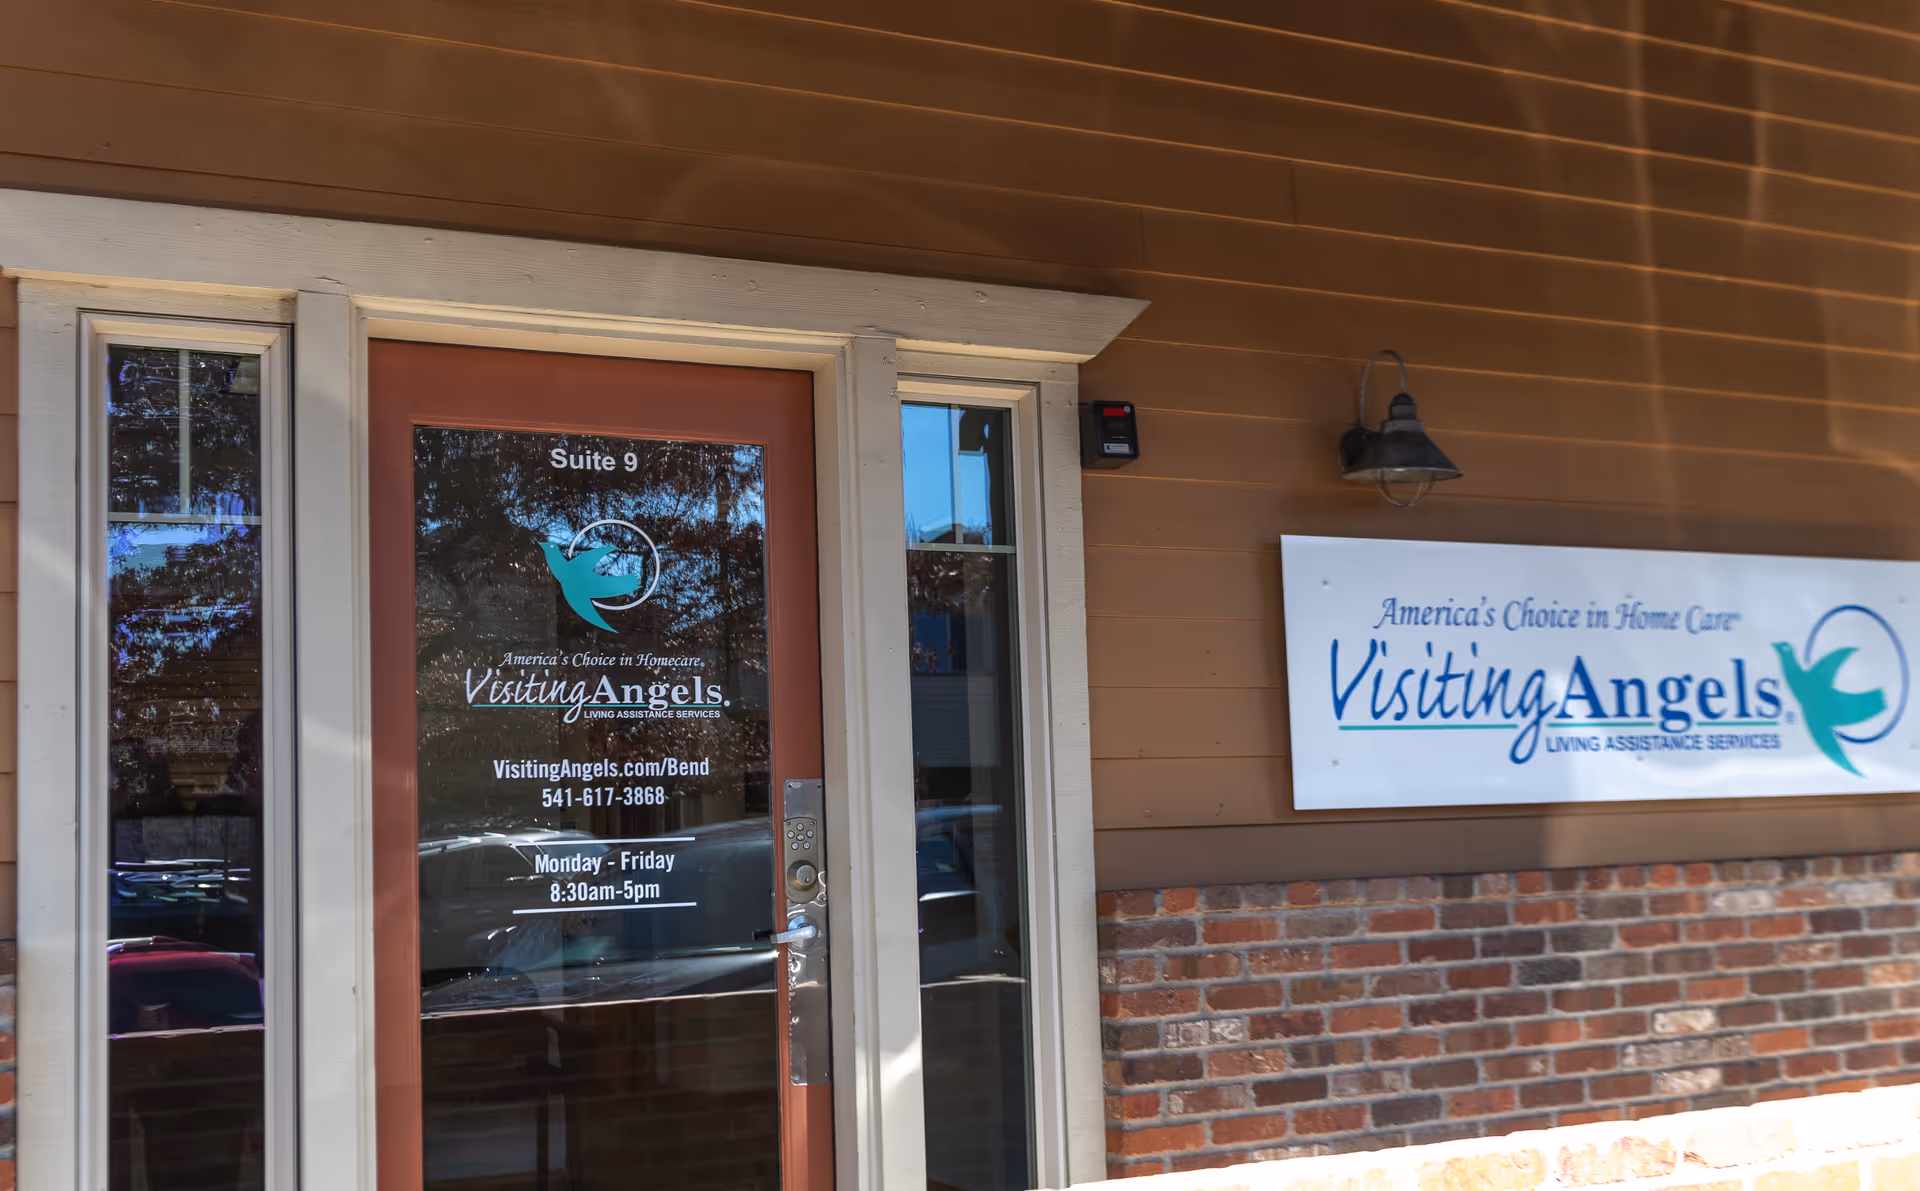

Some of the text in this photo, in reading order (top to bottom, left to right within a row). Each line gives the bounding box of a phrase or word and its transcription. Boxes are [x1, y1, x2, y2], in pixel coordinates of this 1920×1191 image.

[550, 448, 639, 472] Suite 9
[1372, 595, 1497, 630] America's
[1503, 597, 1582, 631] Choice
[1586, 601, 1610, 629] in
[1612, 601, 1682, 631] Home
[498, 651, 569, 667] America's
[572, 651, 617, 668] Choice
[619, 653, 633, 666] in
[465, 667, 592, 724] Visiting
[1330, 637, 1557, 765] Visiting
[584, 710, 721, 719] LIVING ASSISTANCE SERVICES
[1545, 733, 1782, 753] LIVING ASSISTANCE SERVICES
[493, 757, 710, 781] VisitingAngels.com/Bend
[541, 786, 666, 808] 541-617-3868
[534, 853, 602, 876] Monday
[620, 850, 675, 873] Friday
[549, 880, 661, 903] 8:30am-5pm
